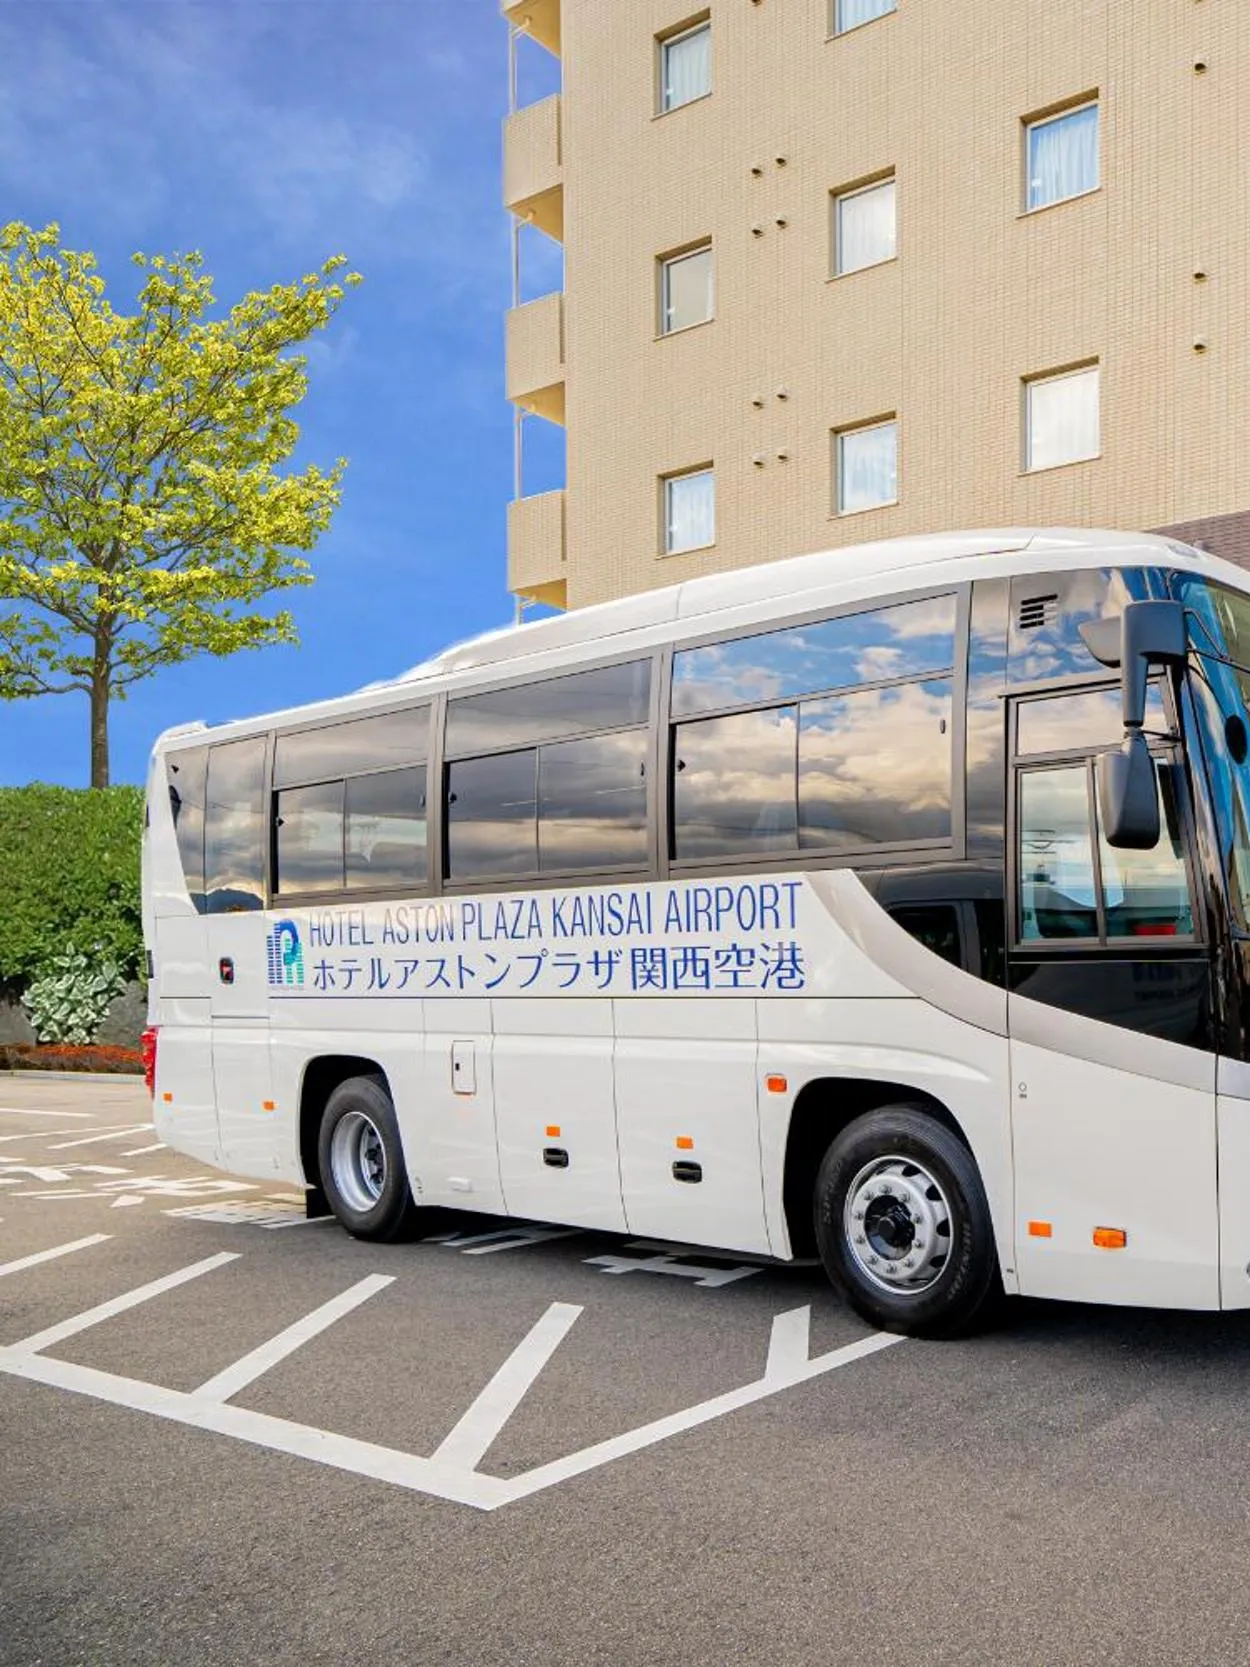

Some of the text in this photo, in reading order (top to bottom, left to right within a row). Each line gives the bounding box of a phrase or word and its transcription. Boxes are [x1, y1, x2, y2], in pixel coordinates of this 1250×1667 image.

[309, 881, 804, 948] HOTEL ASTON PLAZA KANSAI AIRPORT
[313, 940, 806, 991] ホテルアストンプラザ関西空港
